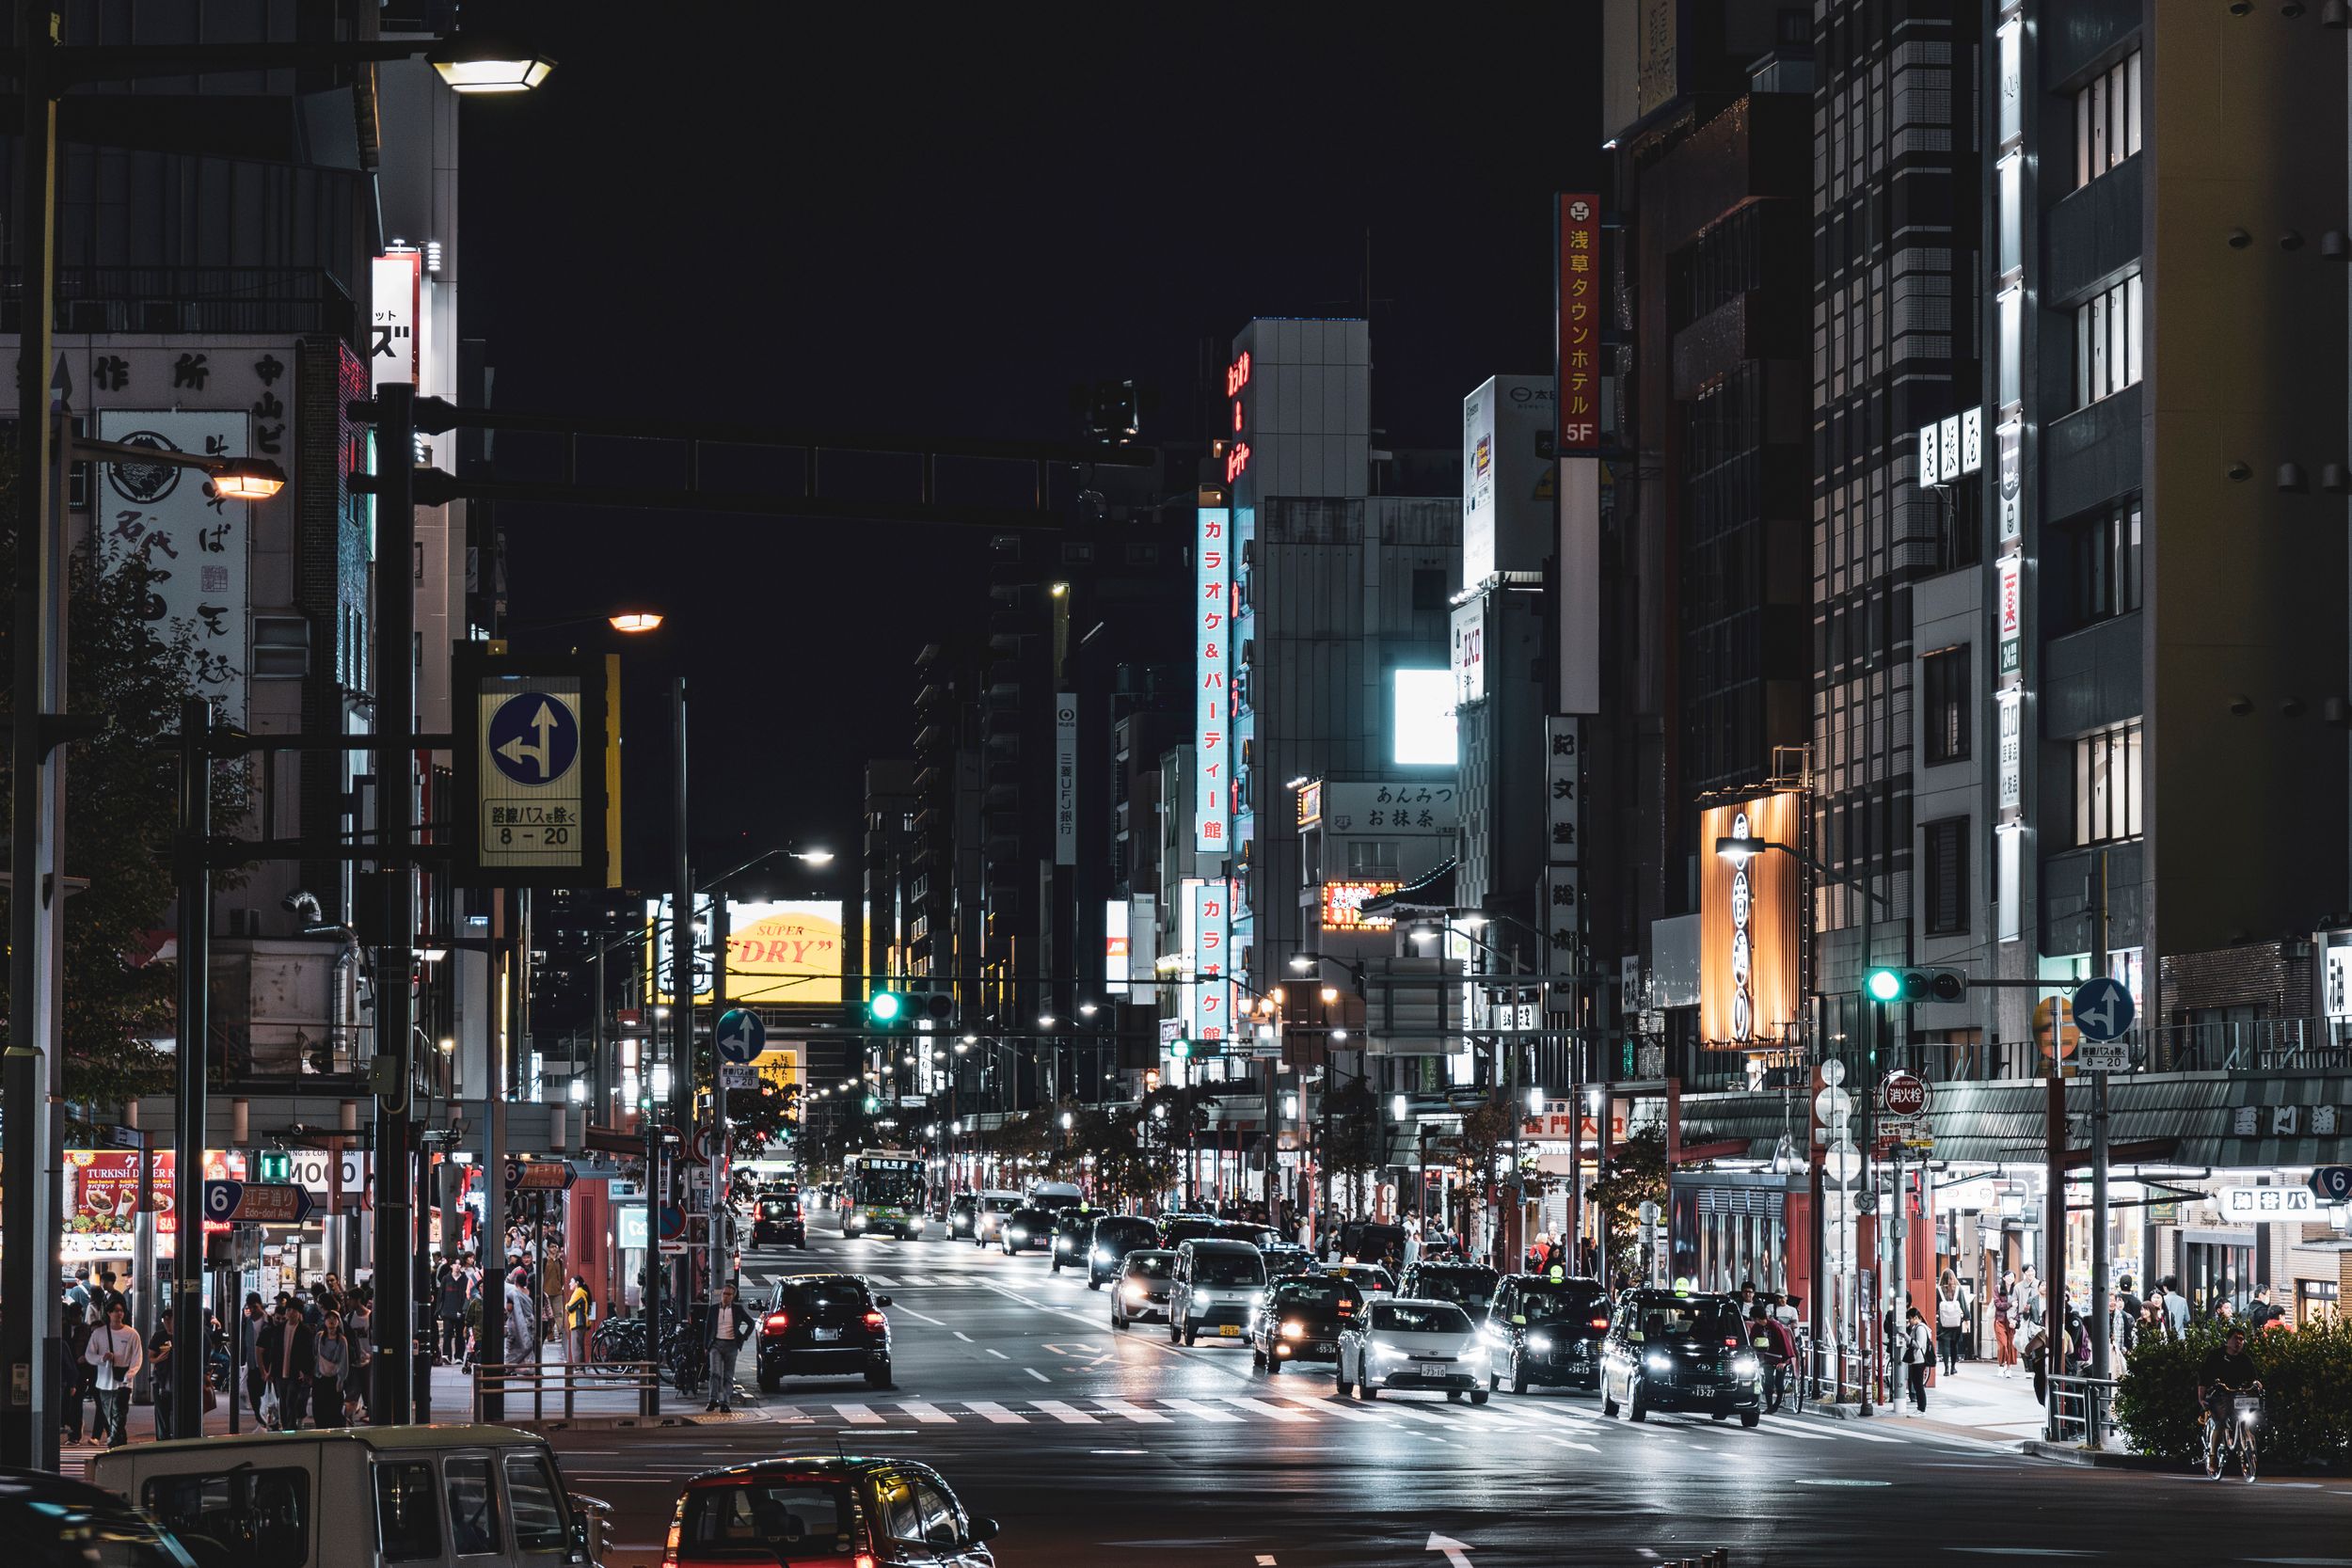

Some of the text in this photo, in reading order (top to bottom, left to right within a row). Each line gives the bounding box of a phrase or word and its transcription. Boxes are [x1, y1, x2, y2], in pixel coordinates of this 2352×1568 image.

[1570, 230, 1589, 414] 浅草タウンホテル
[255, 354, 285, 455] 中山ビ
[1566, 423, 1593, 441] 5F
[1204, 521, 1222, 839] カラオケ&パーティー館
[1060, 752, 1073, 834] 三菱UFJ銀行
[1377, 785, 1452, 804] あんみつ
[492, 806, 576, 824] 路線バスを除く
[1369, 809, 1435, 827] お抹茶
[501, 828, 512, 844] 8
[545, 828, 568, 844] 20
[756, 925, 804, 936] SUPER
[1203, 899, 1221, 1039] カラオケ館
[2087, 1058, 2093, 1068] 8
[2106, 1058, 2122, 1068] 20
[1890, 1088, 1922, 1103] 消火栓
[87, 1169, 165, 1179] TURKISH DER
[505, 1163, 517, 1181] 6
[2331, 1172, 2345, 1190] 6
[211, 1185, 229, 1211] 6
[246, 1189, 294, 1207] 江戸通り
[246, 1209, 278, 1218] Edo-dori
